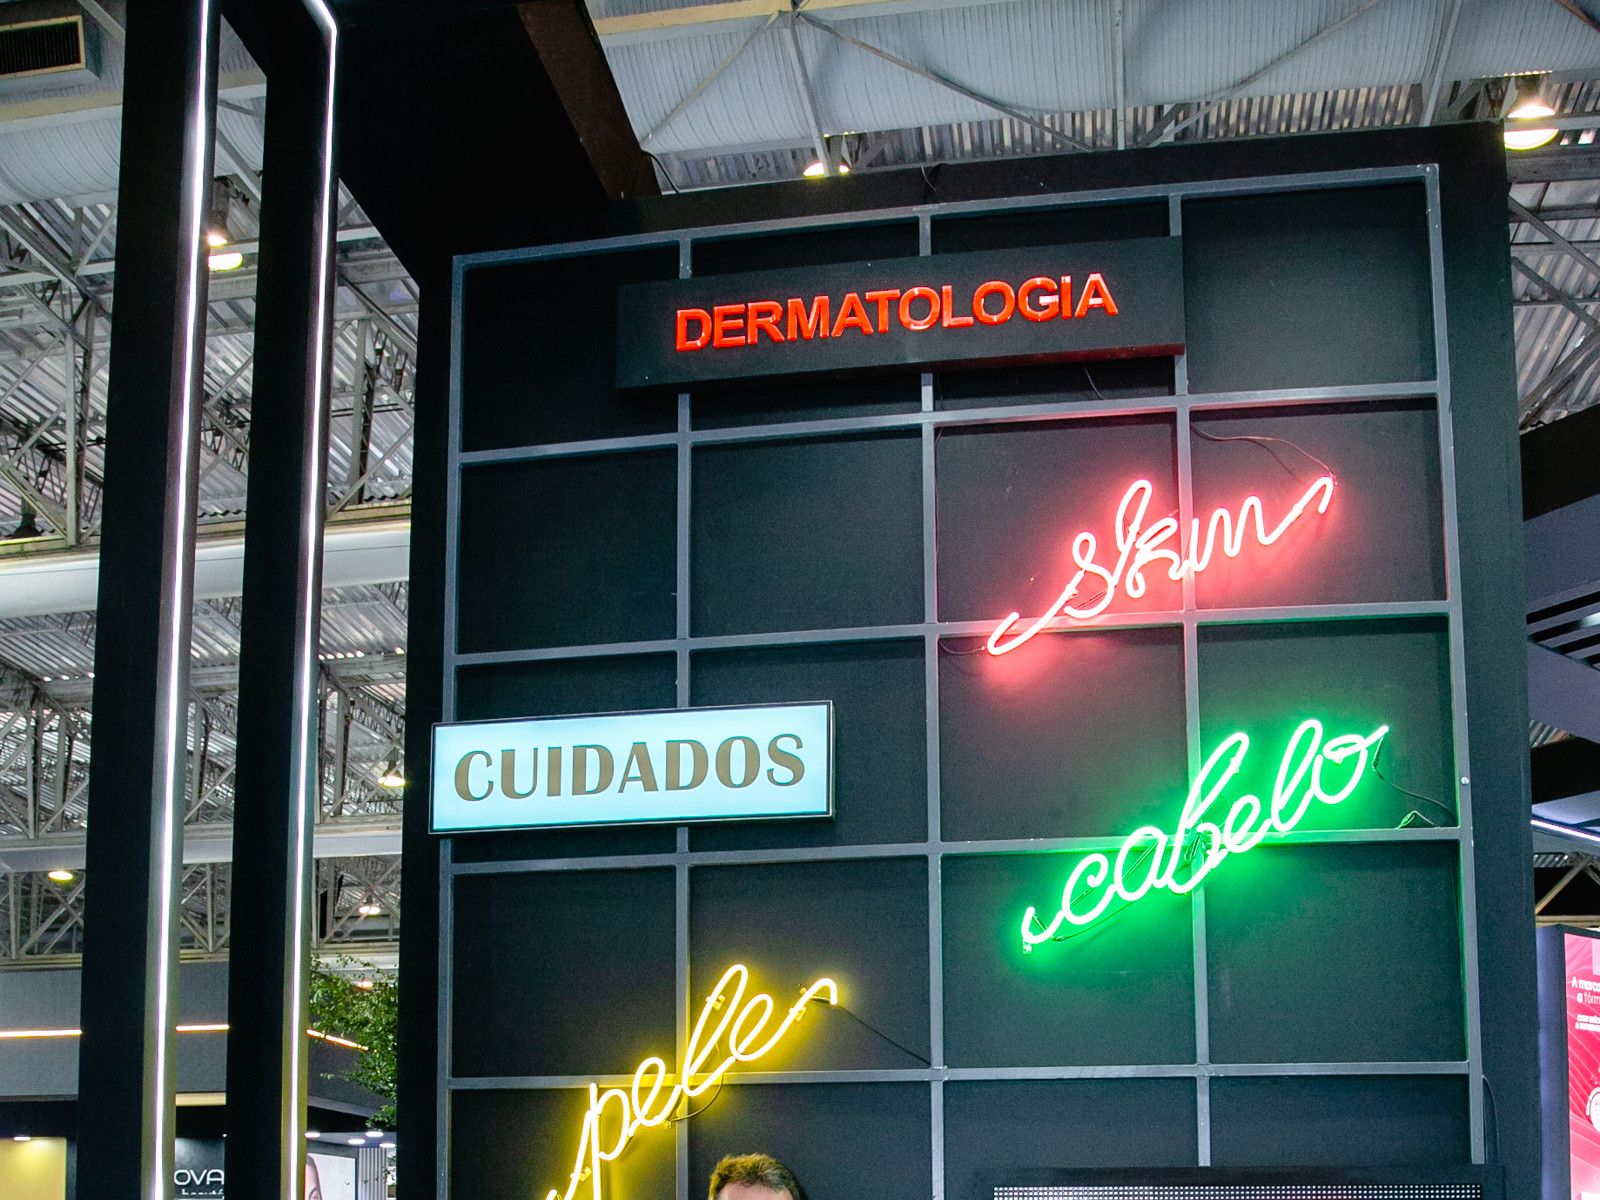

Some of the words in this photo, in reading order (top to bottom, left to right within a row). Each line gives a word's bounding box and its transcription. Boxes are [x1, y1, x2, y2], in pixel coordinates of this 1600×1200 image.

[675, 273, 1119, 352] DERMATOLOGIA
[454, 733, 805, 802] CUIDADOS
[1020, 719, 1389, 947] cabelo
